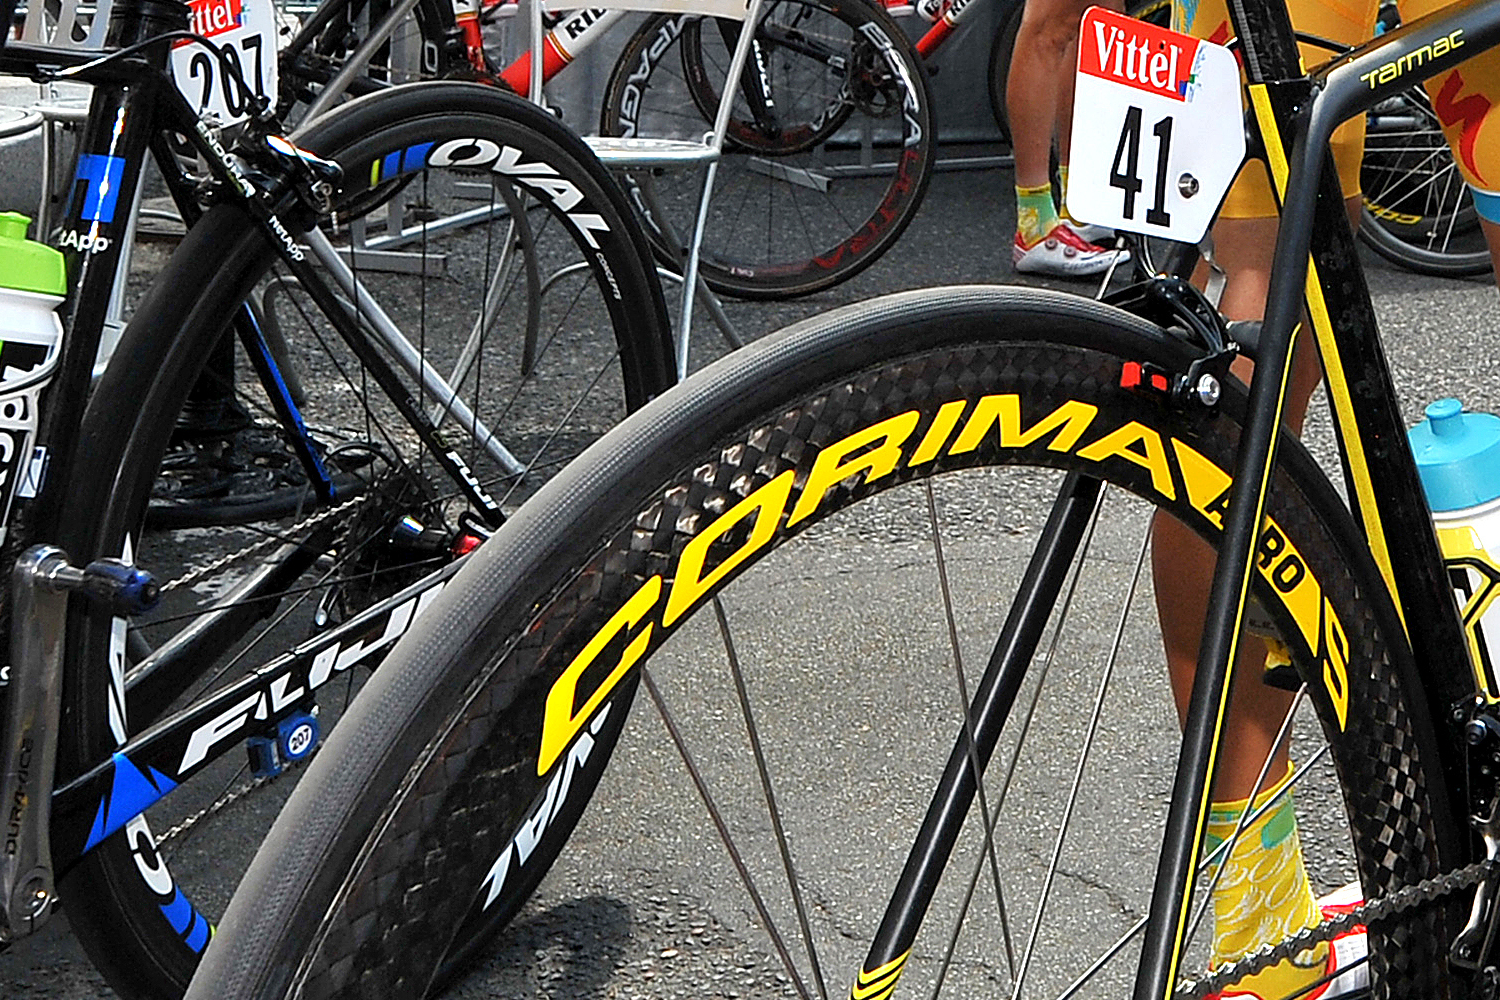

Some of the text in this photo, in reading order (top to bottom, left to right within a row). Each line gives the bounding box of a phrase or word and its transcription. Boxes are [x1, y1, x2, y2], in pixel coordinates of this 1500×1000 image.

[190, 33, 264, 118] 207
[859, 21, 922, 147] BORA
[1093, 20, 1182, 92] Vittel
[1360, 28, 1465, 90] Tarmac
[429, 138, 610, 250] OVAL
[1109, 105, 1173, 228] 41
[268, 214, 304, 262] NetApp
[444, 450, 499, 511] FUJI
[538, 393, 1177, 777] CORIMA
[178, 580, 449, 776] FUJI
[290, 727, 310, 752] 207
